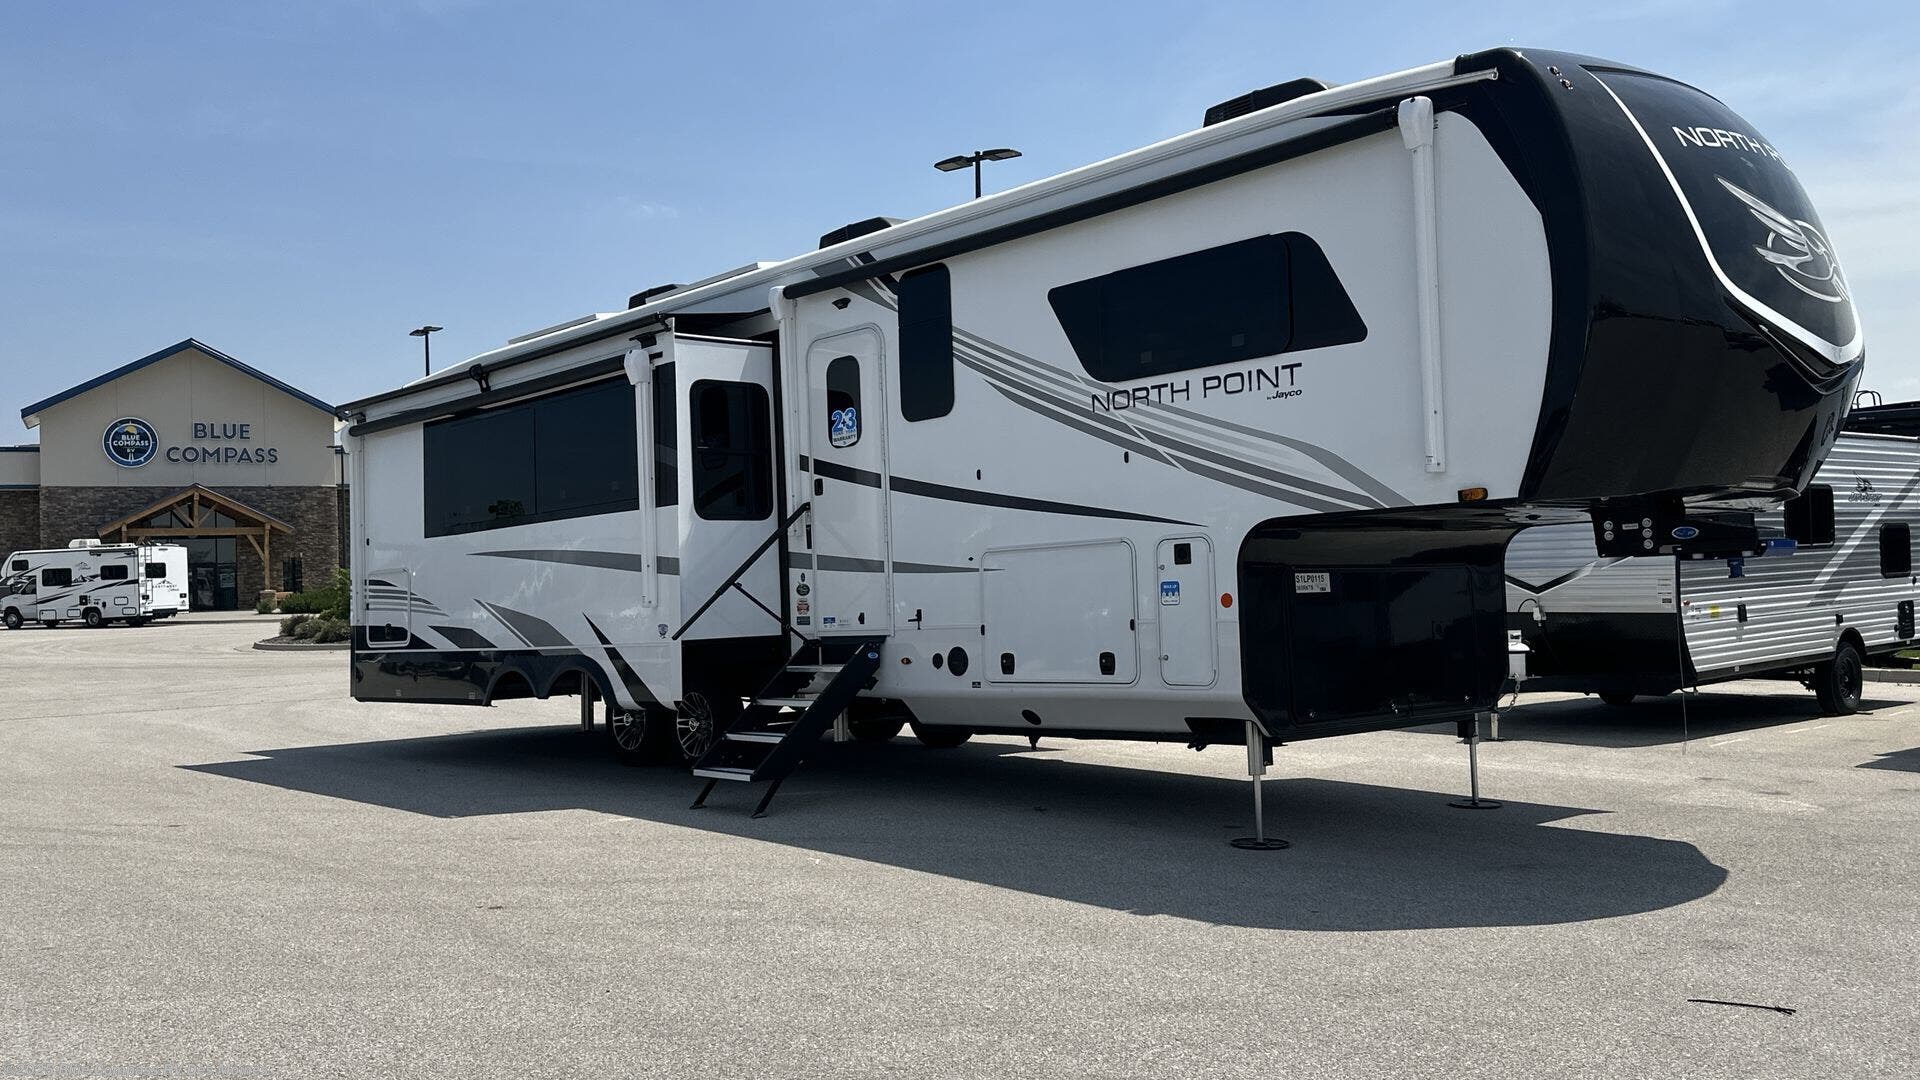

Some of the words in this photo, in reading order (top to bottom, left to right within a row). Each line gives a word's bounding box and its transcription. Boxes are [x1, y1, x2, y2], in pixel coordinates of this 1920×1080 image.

[1671, 126, 1767, 157] NORTH
[1091, 380, 1190, 413] NORTH
[1203, 362, 1303, 399] POINT
[1272, 389, 1303, 400] Jayco
[193, 422, 251, 440] BLUE
[166, 446, 279, 464] COMPASS
